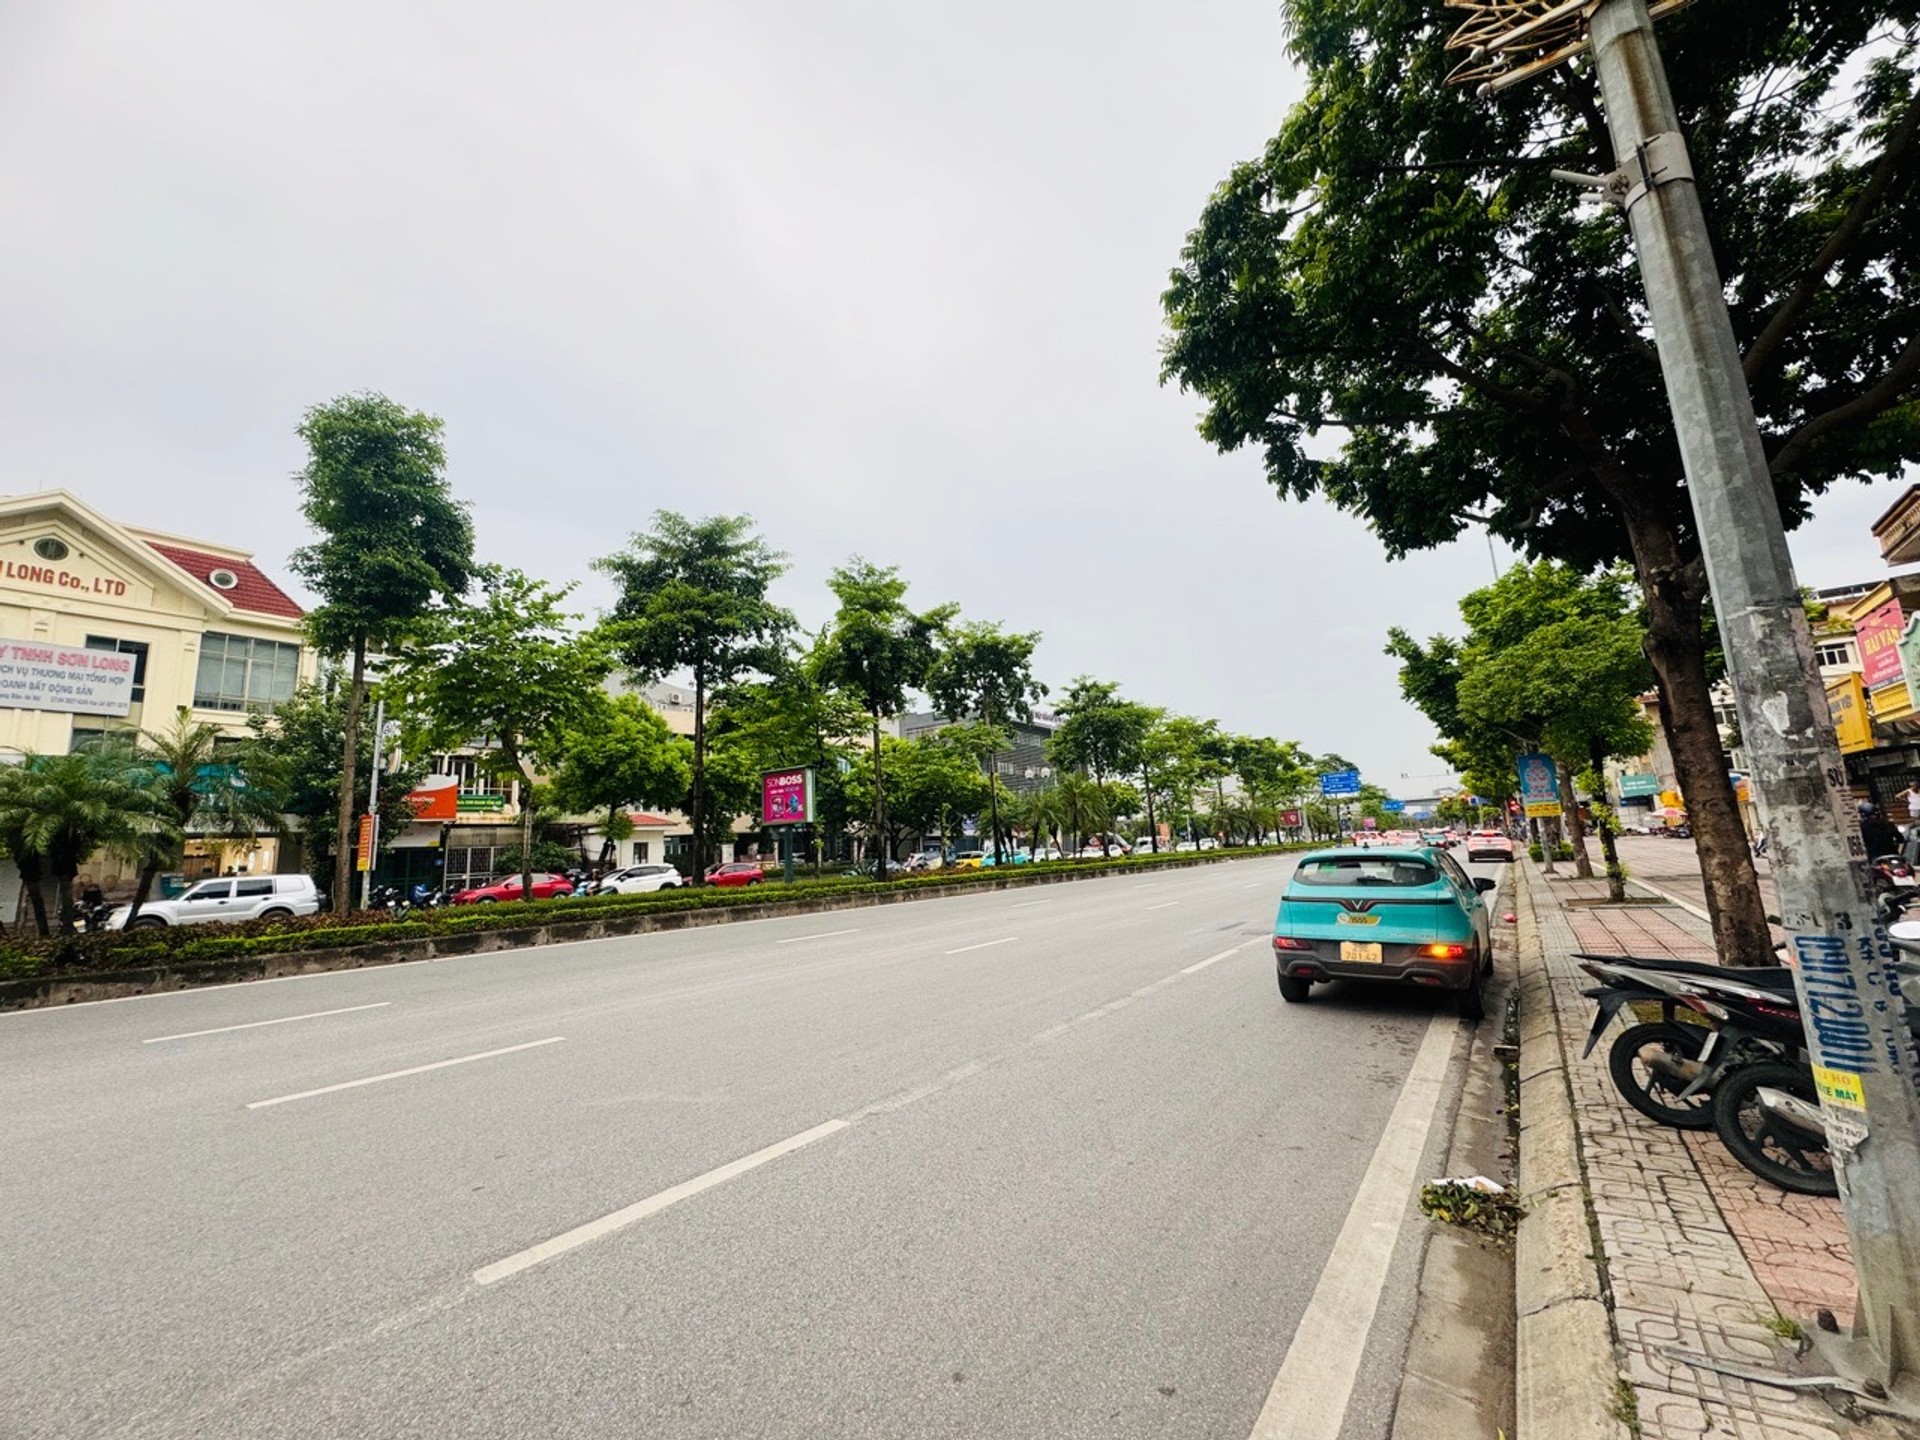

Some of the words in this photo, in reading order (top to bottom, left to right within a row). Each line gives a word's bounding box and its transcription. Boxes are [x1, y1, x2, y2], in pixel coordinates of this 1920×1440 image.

[6, 561, 55, 585] LONG
[59, 571, 90, 592] Co.,
[93, 577, 126, 596] LTD
[11, 646, 54, 663] TNHH
[92, 655, 130, 672] LONG
